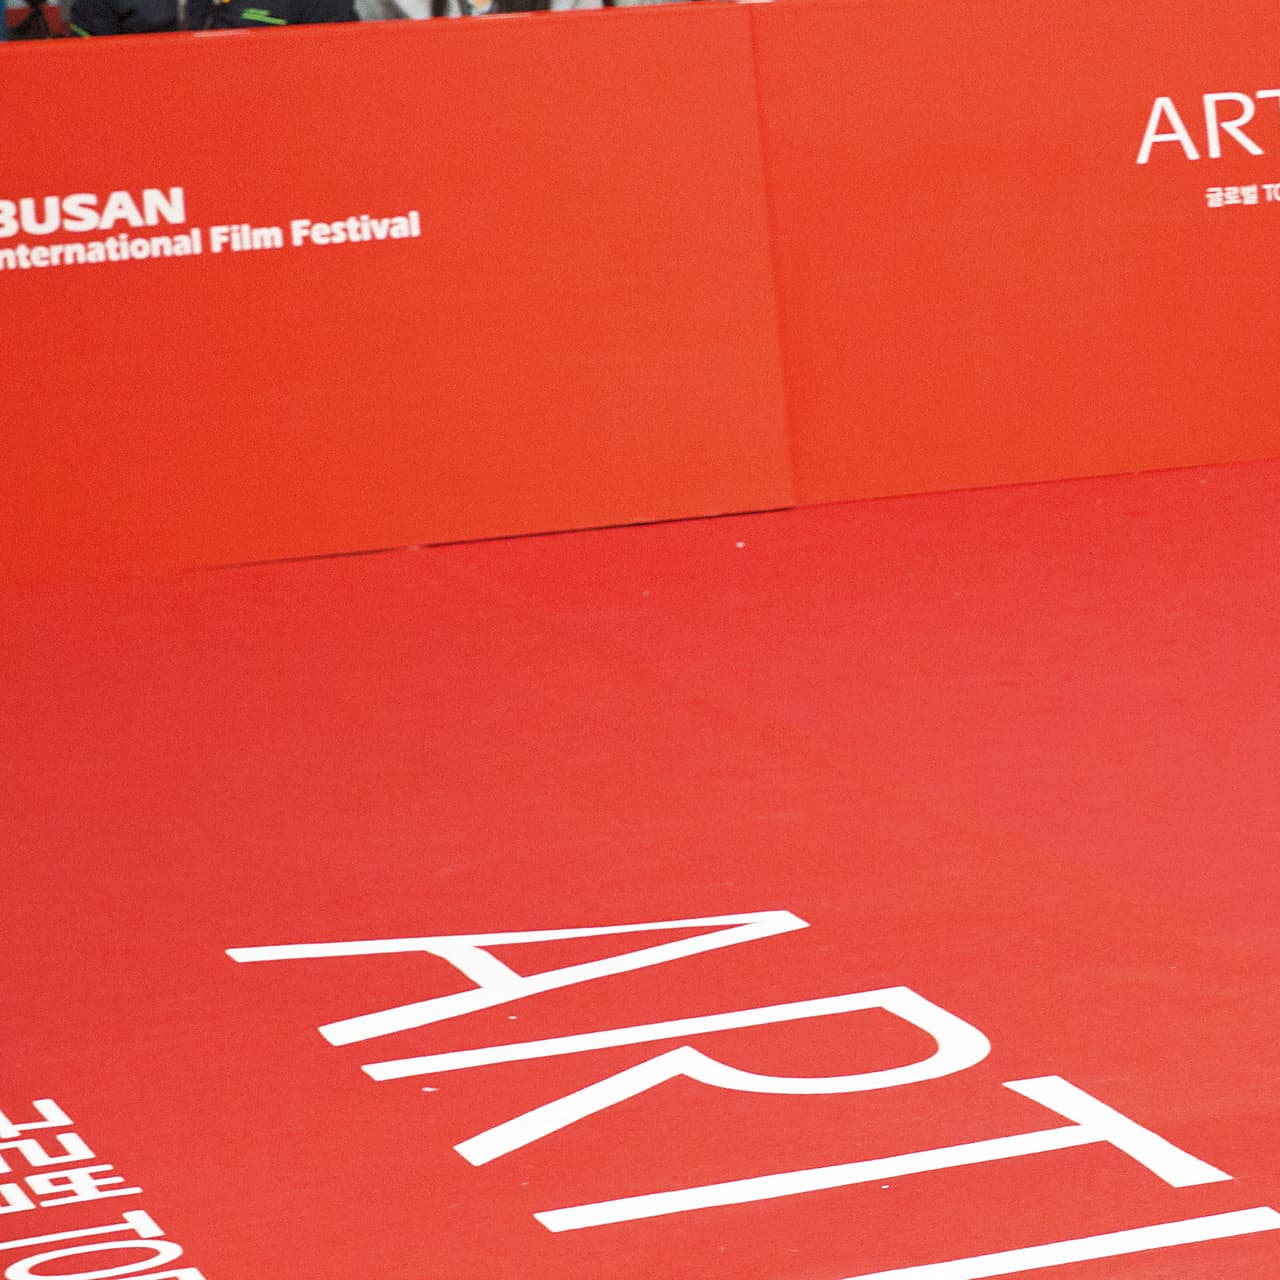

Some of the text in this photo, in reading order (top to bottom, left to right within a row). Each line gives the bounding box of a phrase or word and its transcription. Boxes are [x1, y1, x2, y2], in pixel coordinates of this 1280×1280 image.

[1205, 184, 1259, 208] 글로벌
[0, 210, 421, 271] nternational Film Festival
